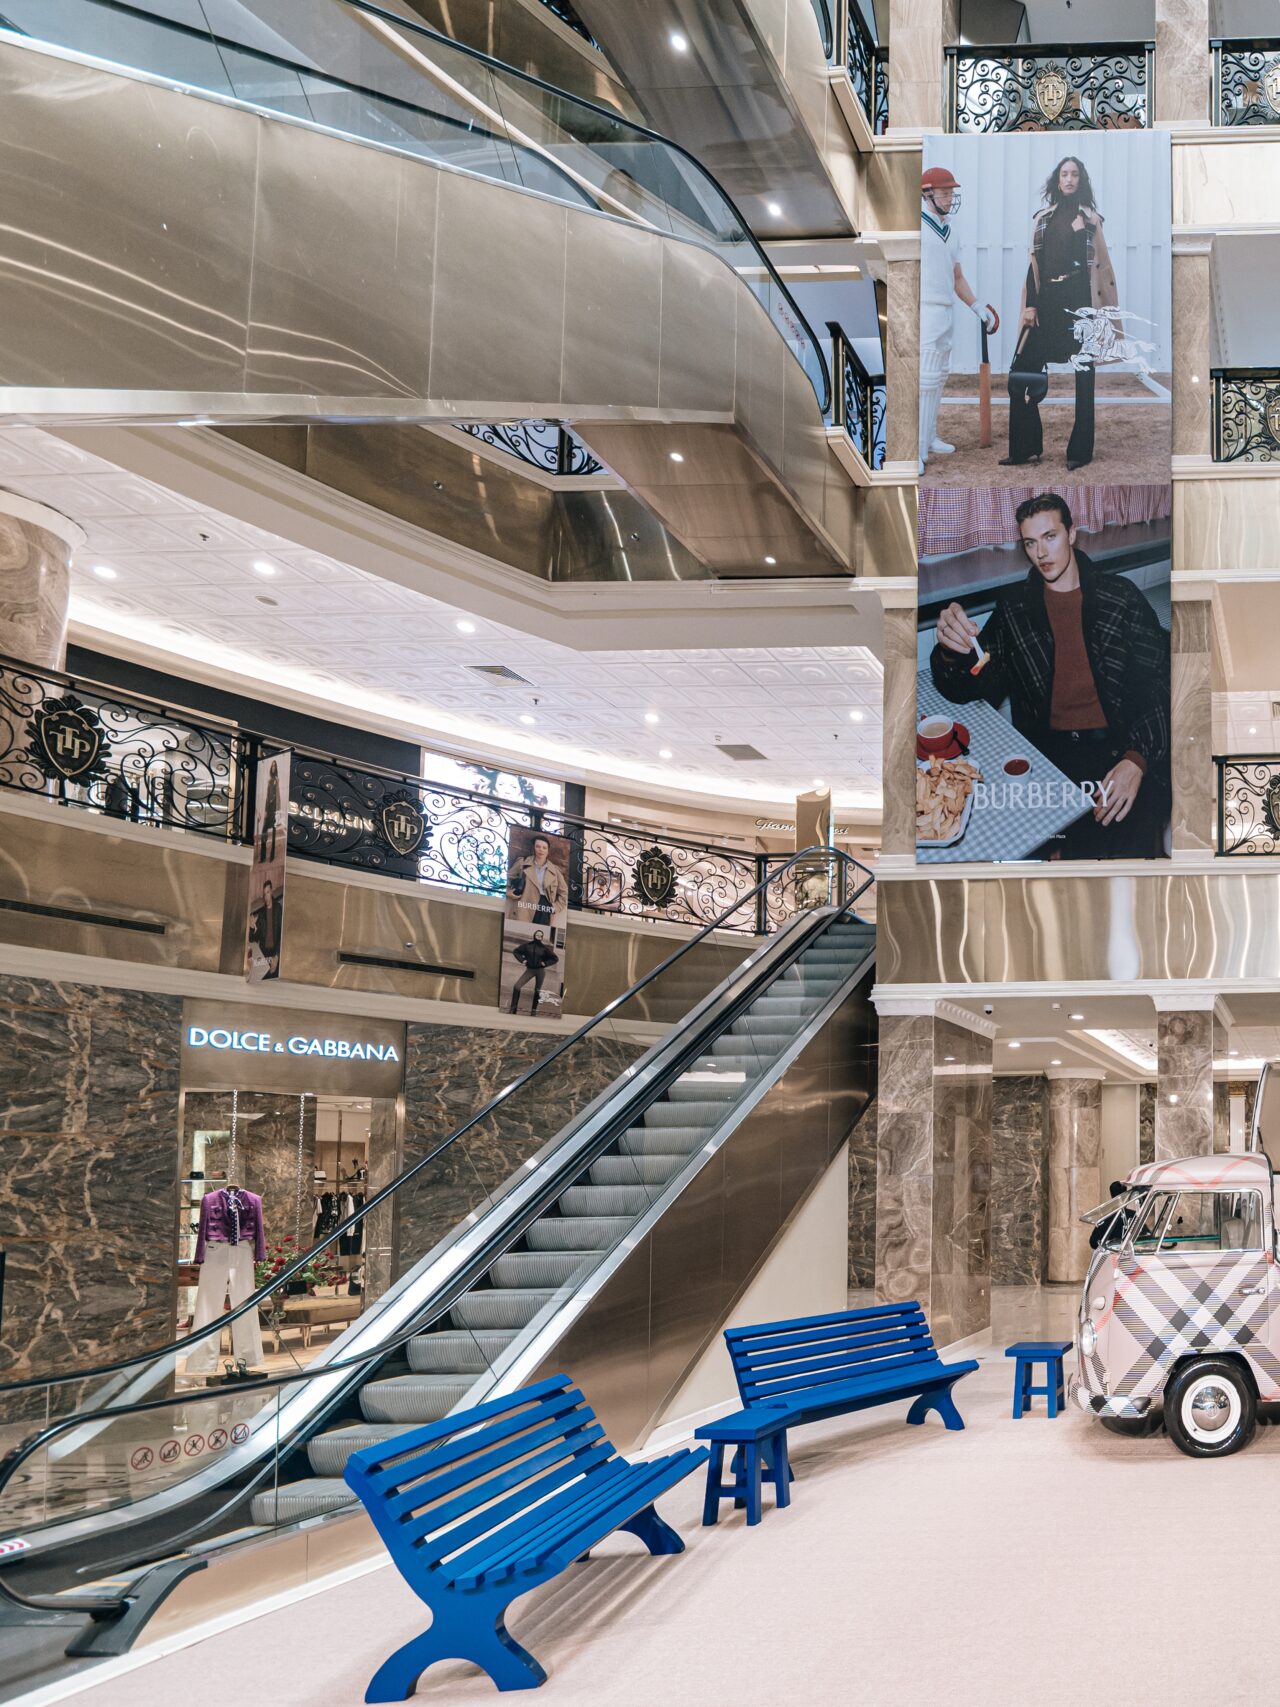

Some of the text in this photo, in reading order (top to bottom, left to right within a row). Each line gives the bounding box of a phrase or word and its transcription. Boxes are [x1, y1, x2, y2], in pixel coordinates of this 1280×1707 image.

[973, 780, 1115, 811] BURBERRY
[517, 900, 556, 914] BURBERRY
[188, 1028, 399, 1062] DOLCE & GABBANA
